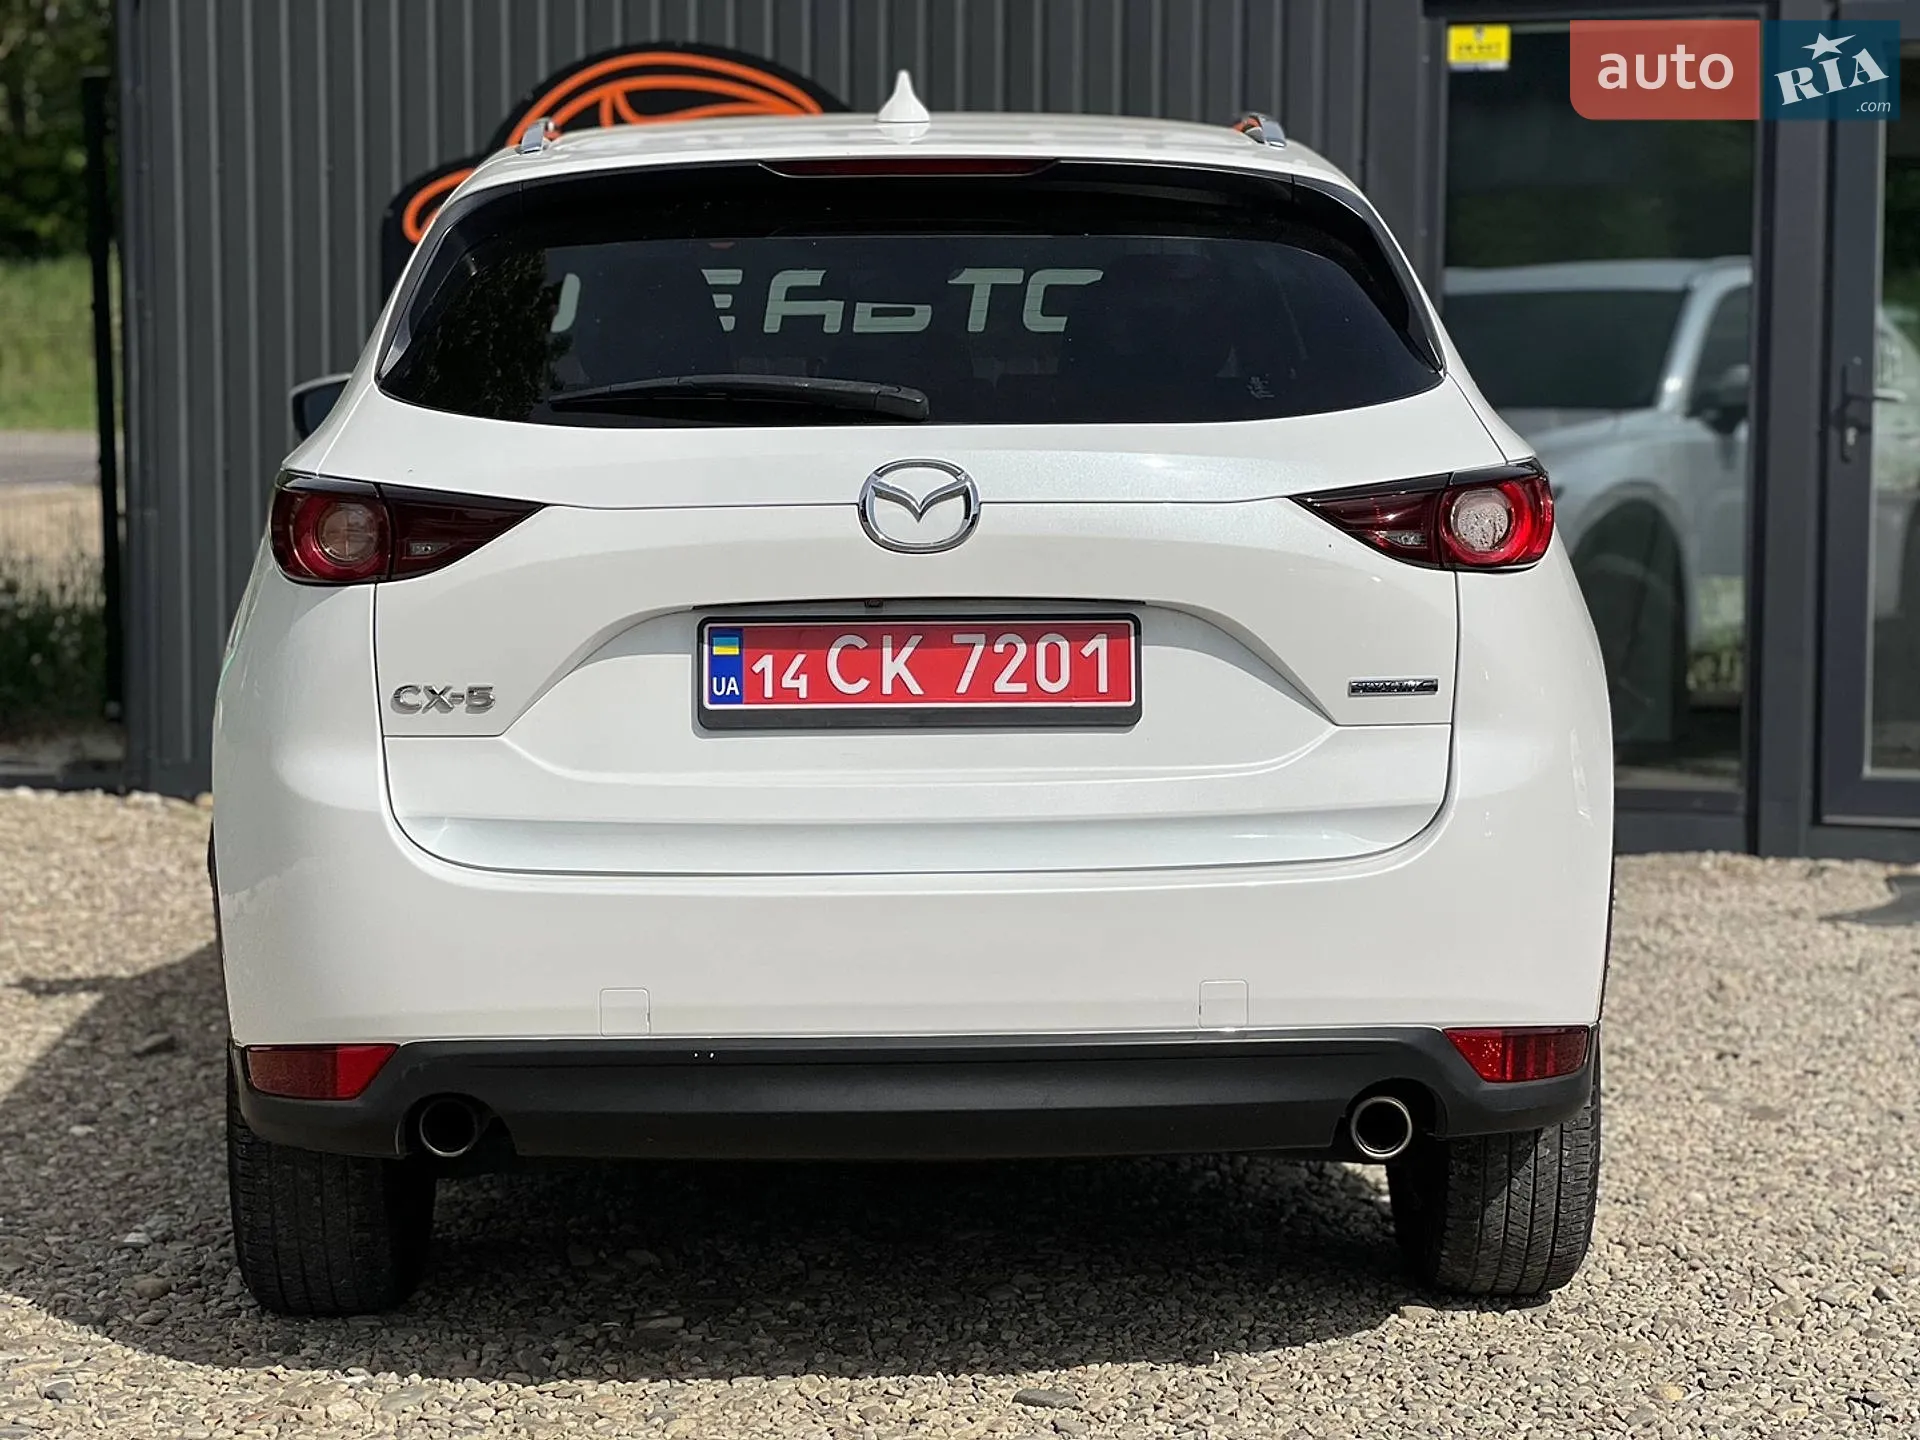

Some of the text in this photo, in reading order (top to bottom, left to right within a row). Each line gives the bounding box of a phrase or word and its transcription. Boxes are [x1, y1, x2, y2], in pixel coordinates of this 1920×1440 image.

[751, 632, 1109, 699] 14 CK 7201
[390, 685, 495, 714] CX-5
[712, 676, 740, 696] UA
